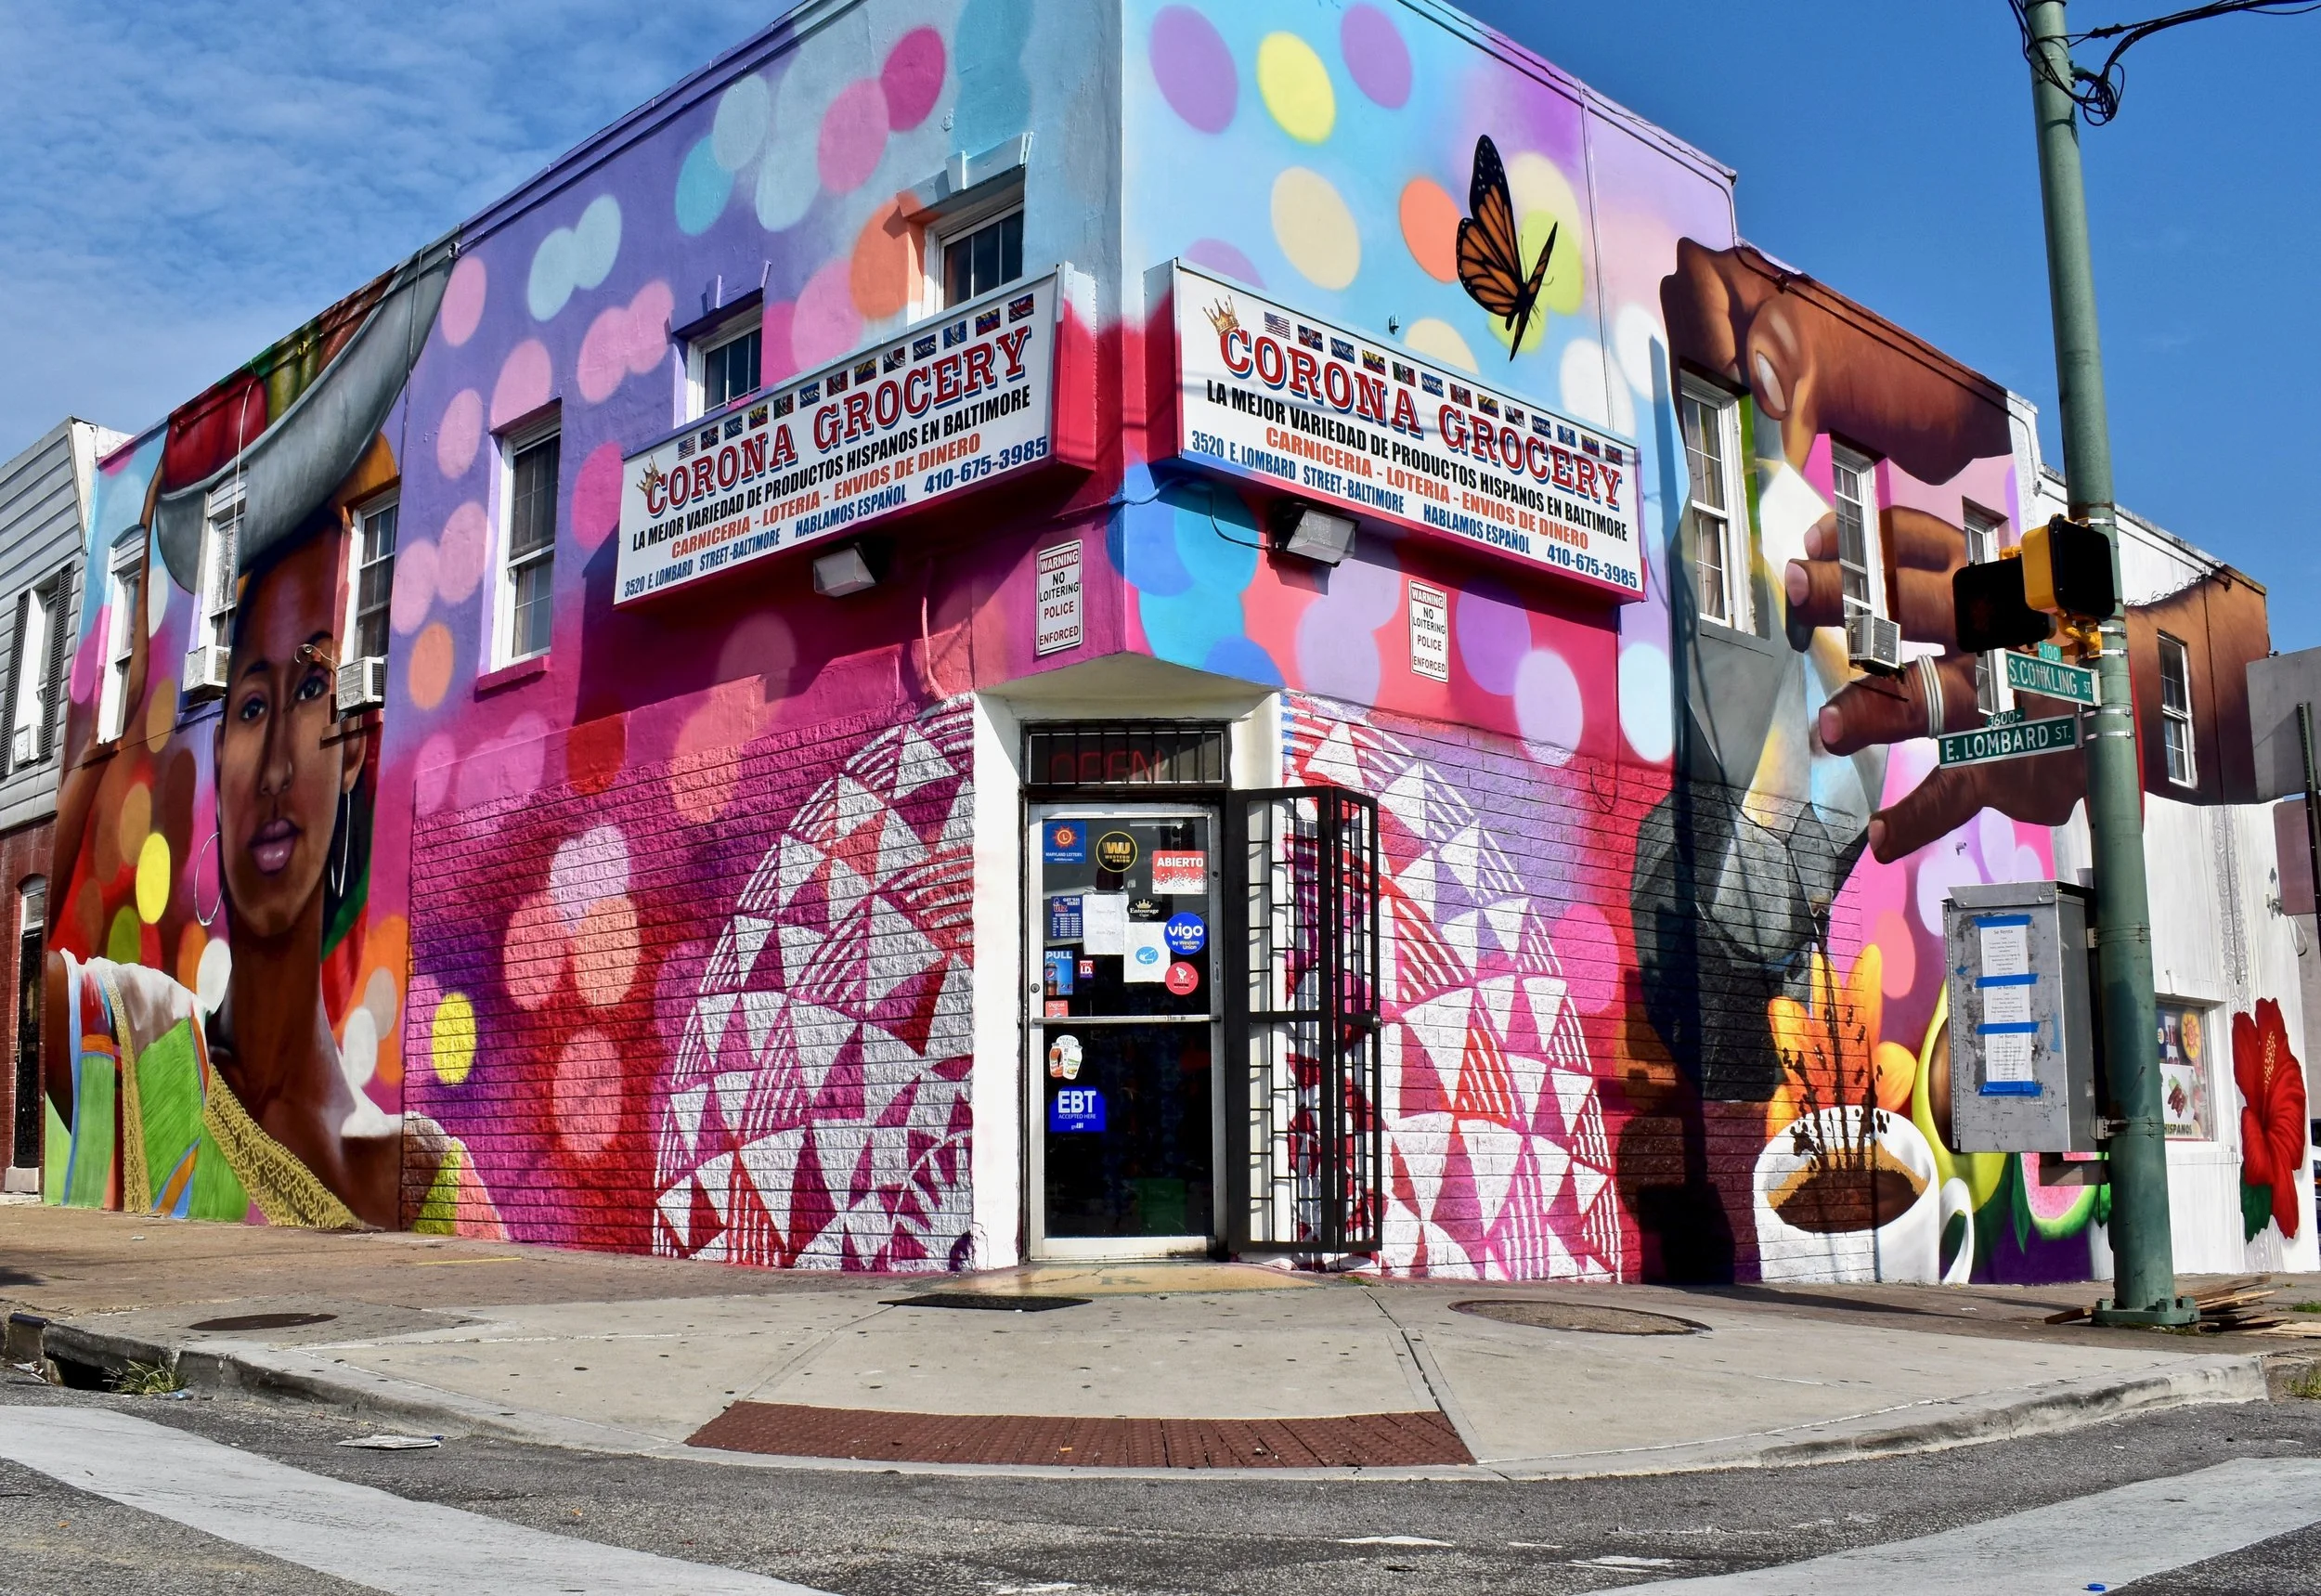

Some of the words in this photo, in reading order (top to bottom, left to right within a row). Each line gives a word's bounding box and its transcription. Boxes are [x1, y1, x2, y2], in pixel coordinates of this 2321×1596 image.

[646, 423, 798, 518] CORONA
[813, 325, 1032, 454] GROCERY
[1219, 329, 1424, 441] CORONA
[1439, 404, 1623, 512] GROCERY
[633, 529, 646, 551] LA
[648, 516, 684, 546] MEJOR
[686, 493, 745, 532] VARIEDAD
[746, 486, 762, 510] DE
[765, 455, 843, 502] PRODUCTOS
[847, 427, 917, 472] HISPANOS
[922, 419, 940, 446] EN
[943, 384, 1031, 437] BALTIMORE
[1207, 379, 1227, 407] LA
[1231, 387, 1286, 424] MEJOR
[1289, 406, 1367, 451] VARIEDAD
[1370, 434, 1388, 460] DE
[1392, 441, 1477, 489] PRODUCTOS
[1480, 473, 1544, 512] HISPANOS
[1547, 495, 1562, 518] EN
[1564, 501, 1627, 542] BALTIMORE
[671, 515, 750, 559] CARNICERIA
[762, 490, 820, 526] LOTERIA
[834, 465, 890, 501] ENVIOS
[894, 456, 914, 480] DE
[918, 433, 980, 472] DINERO
[1265, 426, 1372, 478] CARNICERIA
[1386, 466, 1450, 504] LOTERIA
[1462, 491, 1515, 526] ENVIOS
[1519, 511, 1536, 532] DE
[1539, 517, 1588, 550] DINERO
[624, 576, 645, 597] 3520
[655, 559, 694, 588] LOMBARD
[795, 501, 855, 538] HABLAMOS
[857, 485, 907, 517] ESPAÑOL
[924, 435, 1048, 494] 410-675-3985
[1192, 430, 1224, 458] 3520
[1229, 441, 1238, 462] E.
[1241, 445, 1296, 480] LOMBARD
[1423, 503, 1483, 539] HABLAMOS
[1486, 525, 1530, 554] ESPAÑOL
[1547, 544, 1637, 589] 410-675-3985
[1041, 550, 1079, 573] WARNING
[1052, 571, 1065, 586] NO
[1040, 582, 1079, 603] LOITERING
[1412, 588, 1443, 608] WARNING
[1044, 601, 1074, 619] POLICE
[1423, 606, 1433, 619] NO
[1413, 616, 1446, 634] LOITERING
[1040, 625, 1079, 645] ENFORCED
[1417, 634, 1442, 651] POLICE
[2043, 644, 2058, 661] 100
[1413, 655, 1446, 672] ENFORCED
[1989, 711, 2016, 728] 3600
[1946, 740, 1960, 761] E.
[1964, 725, 2049, 759] LOMBARD
[2055, 725, 2071, 741] ST.
[1102, 841, 1131, 854] WU
[1156, 857, 1204, 867] ABIERTO
[1129, 907, 1160, 915] Entourage
[1168, 922, 1204, 940] vigo
[1045, 951, 1073, 959] PULL
[1080, 966, 1093, 974] I.D.
[1058, 1090, 1096, 1113] EBT
